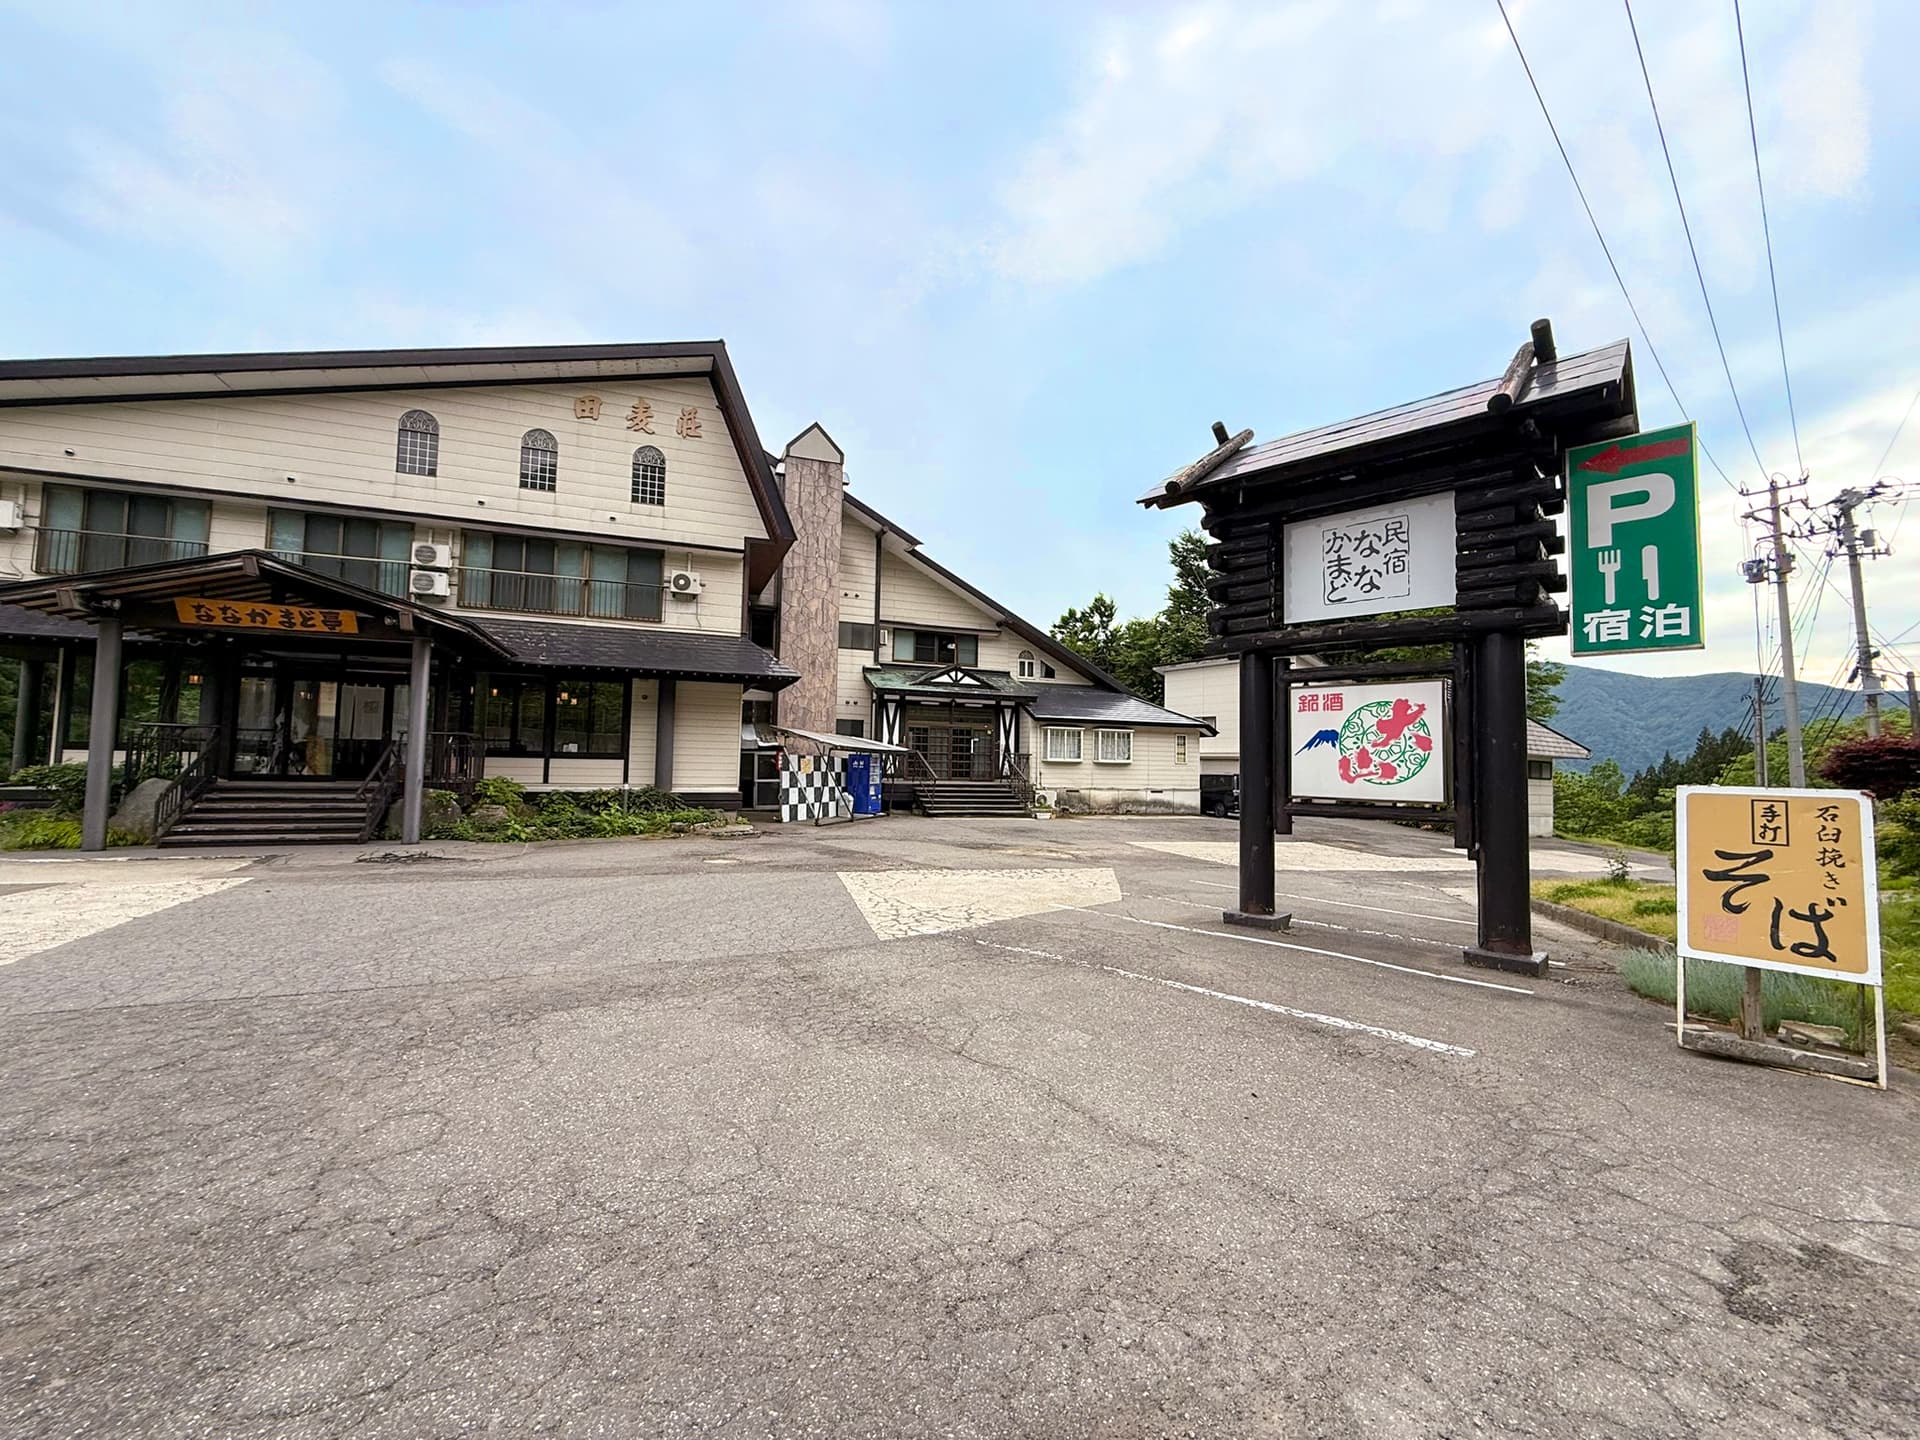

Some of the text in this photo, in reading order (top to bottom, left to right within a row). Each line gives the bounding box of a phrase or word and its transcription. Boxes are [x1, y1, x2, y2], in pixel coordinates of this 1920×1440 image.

[1587, 473, 1676, 549] P
[1324, 531, 1353, 603] かまど
[1352, 530, 1383, 594] なな
[1382, 520, 1409, 575] 民宿
[191, 602, 343, 631] ななかまど亭
[1583, 603, 1691, 643] 宿泊
[1297, 693, 1344, 713] 銘酒
[1759, 804, 1782, 842] 手打
[1814, 804, 1846, 890] 石臼挽き
[1702, 849, 1847, 963] そば
